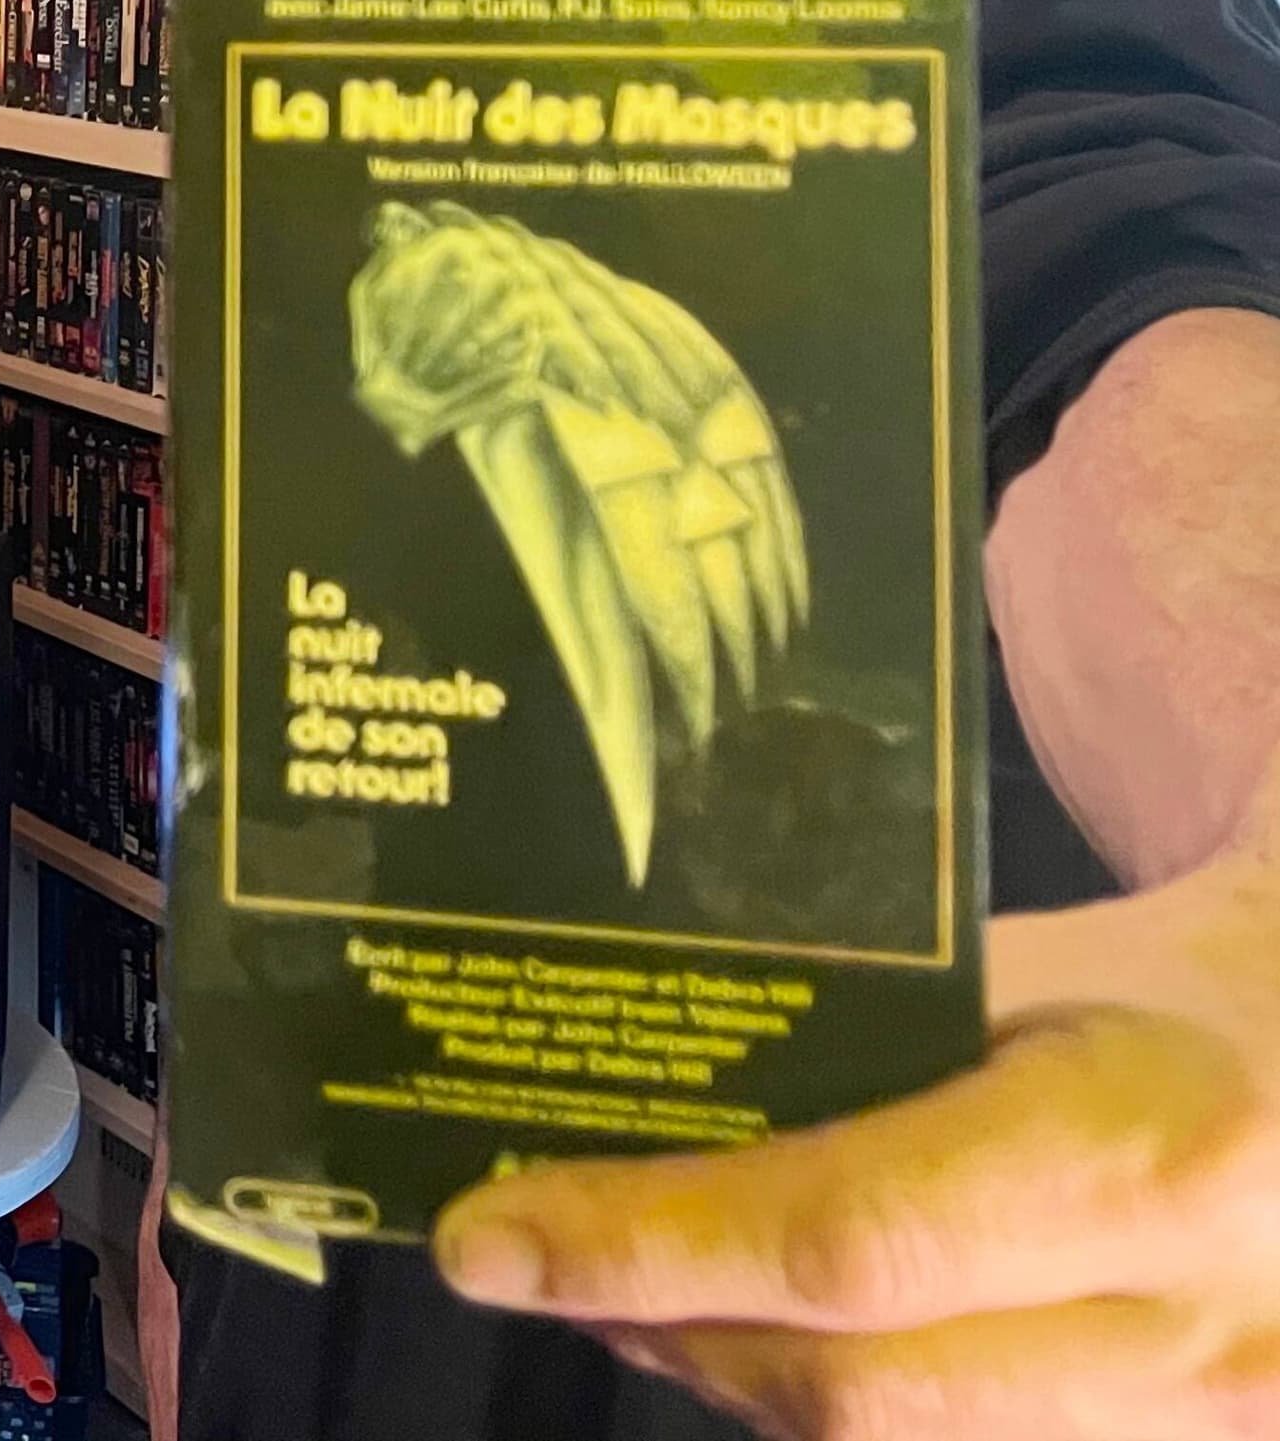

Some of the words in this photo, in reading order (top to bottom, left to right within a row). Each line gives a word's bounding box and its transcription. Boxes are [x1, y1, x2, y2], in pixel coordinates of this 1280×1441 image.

[251, 77, 329, 140] La
[340, 77, 479, 141] Nuit
[483, 77, 604, 145] des
[612, 81, 916, 161] Masques
[288, 570, 346, 619] La
[288, 619, 383, 665] nuit
[288, 662, 506, 719] infernale
[288, 707, 356, 753] de
[360, 720, 448, 758] son
[287, 758, 450, 807] retour!
